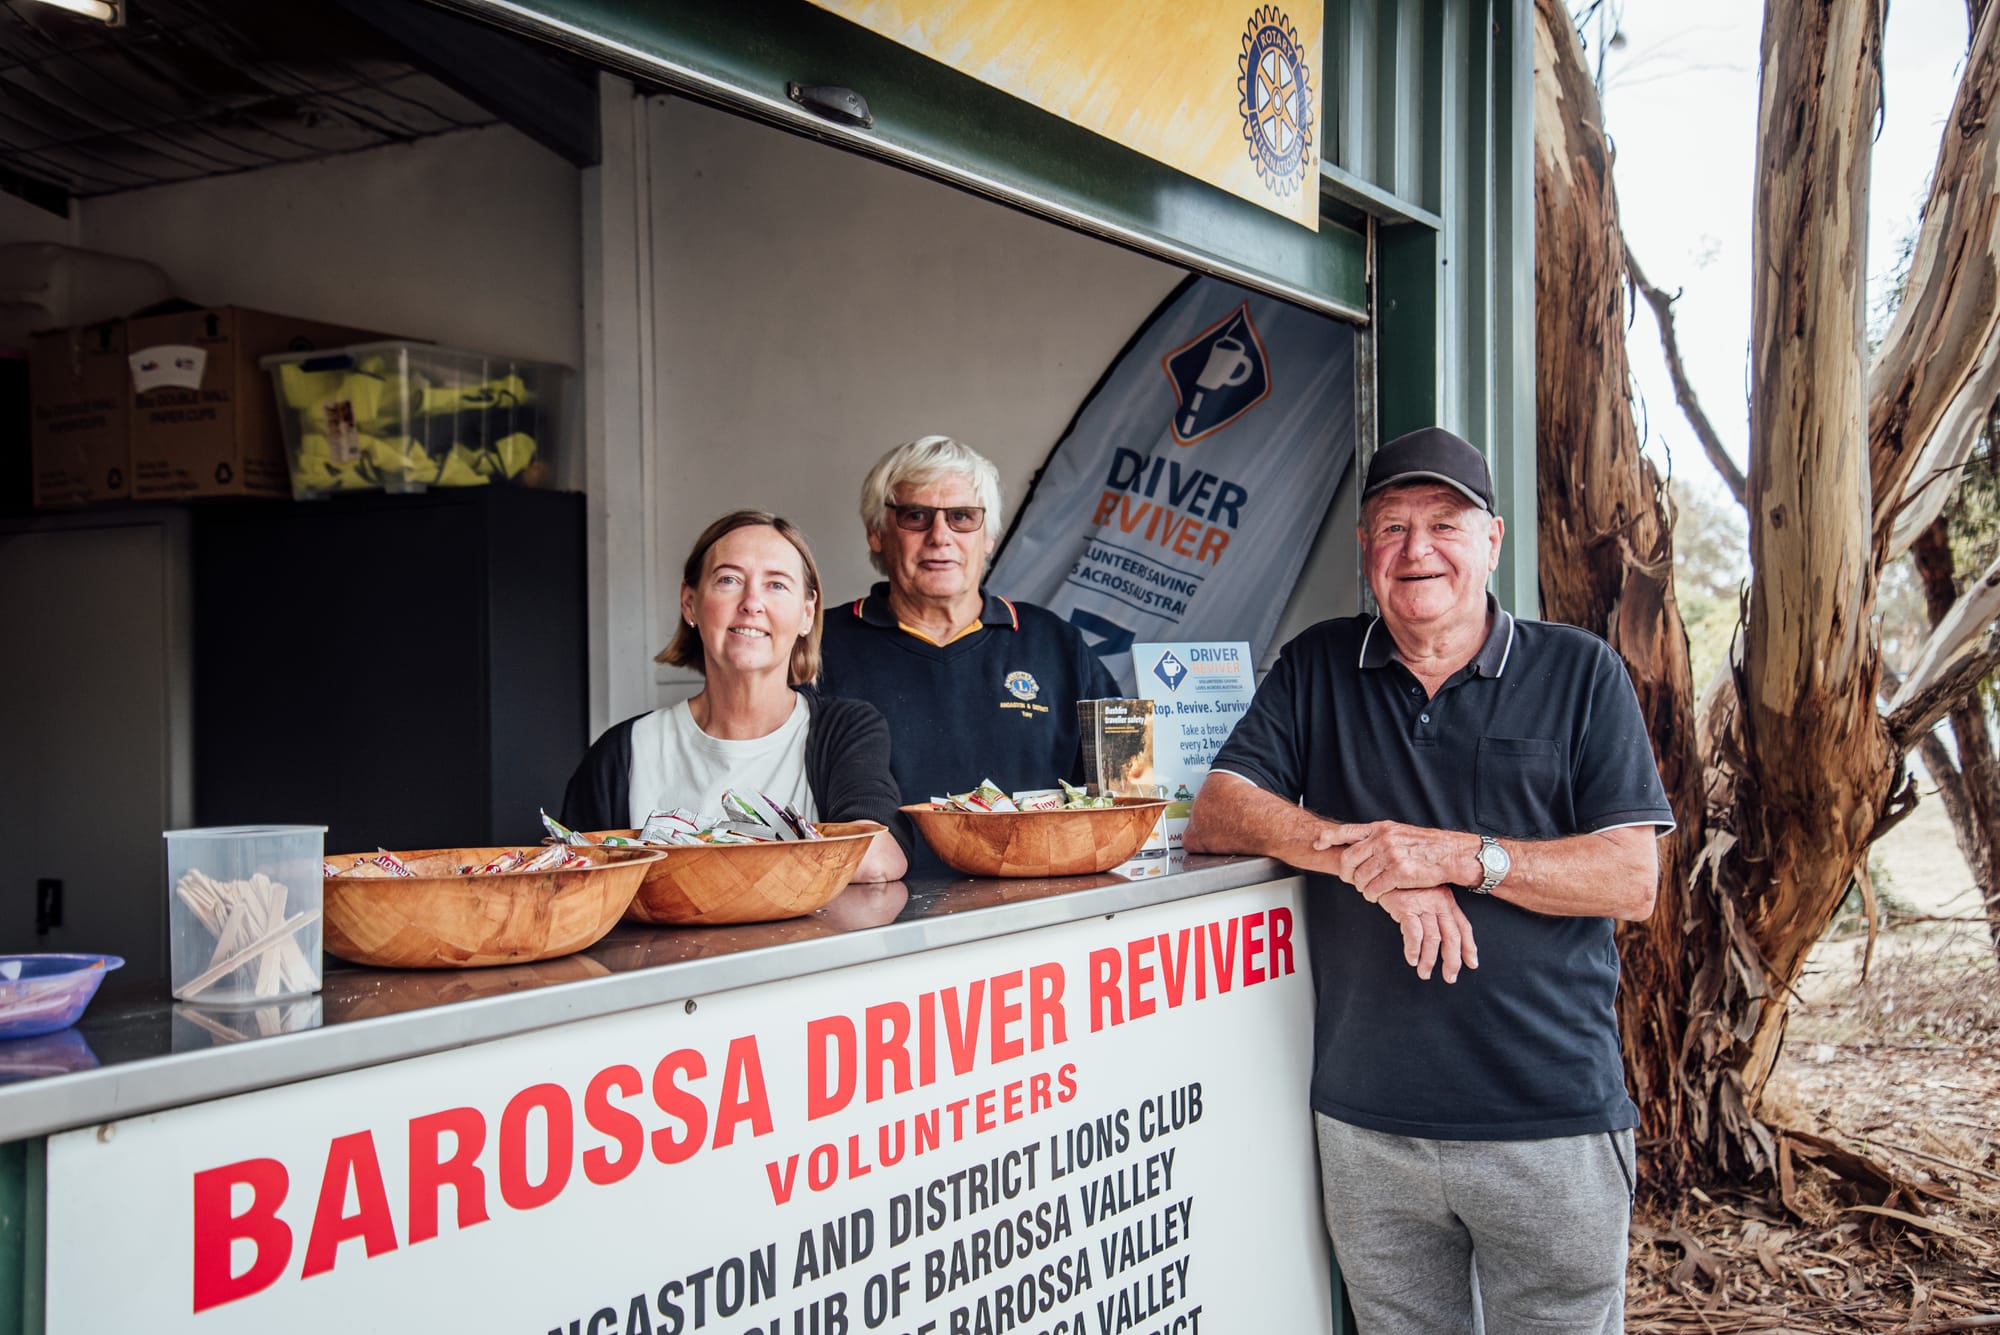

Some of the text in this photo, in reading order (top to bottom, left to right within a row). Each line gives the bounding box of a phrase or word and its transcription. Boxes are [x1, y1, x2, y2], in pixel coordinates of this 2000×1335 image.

[1260, 30, 1293, 57] ROTARY
[1252, 119, 1303, 172] INTERNATIONAL
[1107, 447, 1248, 530] DRIVER
[1092, 490, 1231, 567] RVIVER
[1084, 547, 1149, 579] LUNTEERS
[1132, 588, 1187, 616] AUSTRA
[1190, 648, 1239, 662] DRIVER
[1192, 662, 1240, 674] REVIVER
[1018, 680, 1028, 692] L
[1128, 715, 1145, 725] safety
[1154, 703, 1174, 718] top.
[1177, 701, 1213, 714] Revive.
[1181, 723, 1199, 736] Take
[1201, 726, 1206, 735] a
[1180, 741, 1201, 752] every
[1202, 738, 1208, 749] 2
[1183, 753, 1205, 766] while
[194, 907, 1296, 1314] BAROSSA DRIVER REVIVER
[765, 1063, 1078, 1206] VOLUNTEERS
[793, 1207, 875, 1289] AND
[889, 1141, 1041, 1249] DISTRICT
[1051, 1108, 1130, 1181] LIONS
[1139, 1082, 1203, 1143] CLUB
[864, 1261, 911, 1330] OF
[925, 1194, 1073, 1304] BAROSSA
[1080, 1147, 1177, 1229] VALLEY
[950, 1196, 1194, 1335] BAROSSA VALLEY
[1097, 1254, 1191, 1335] VALLEY
